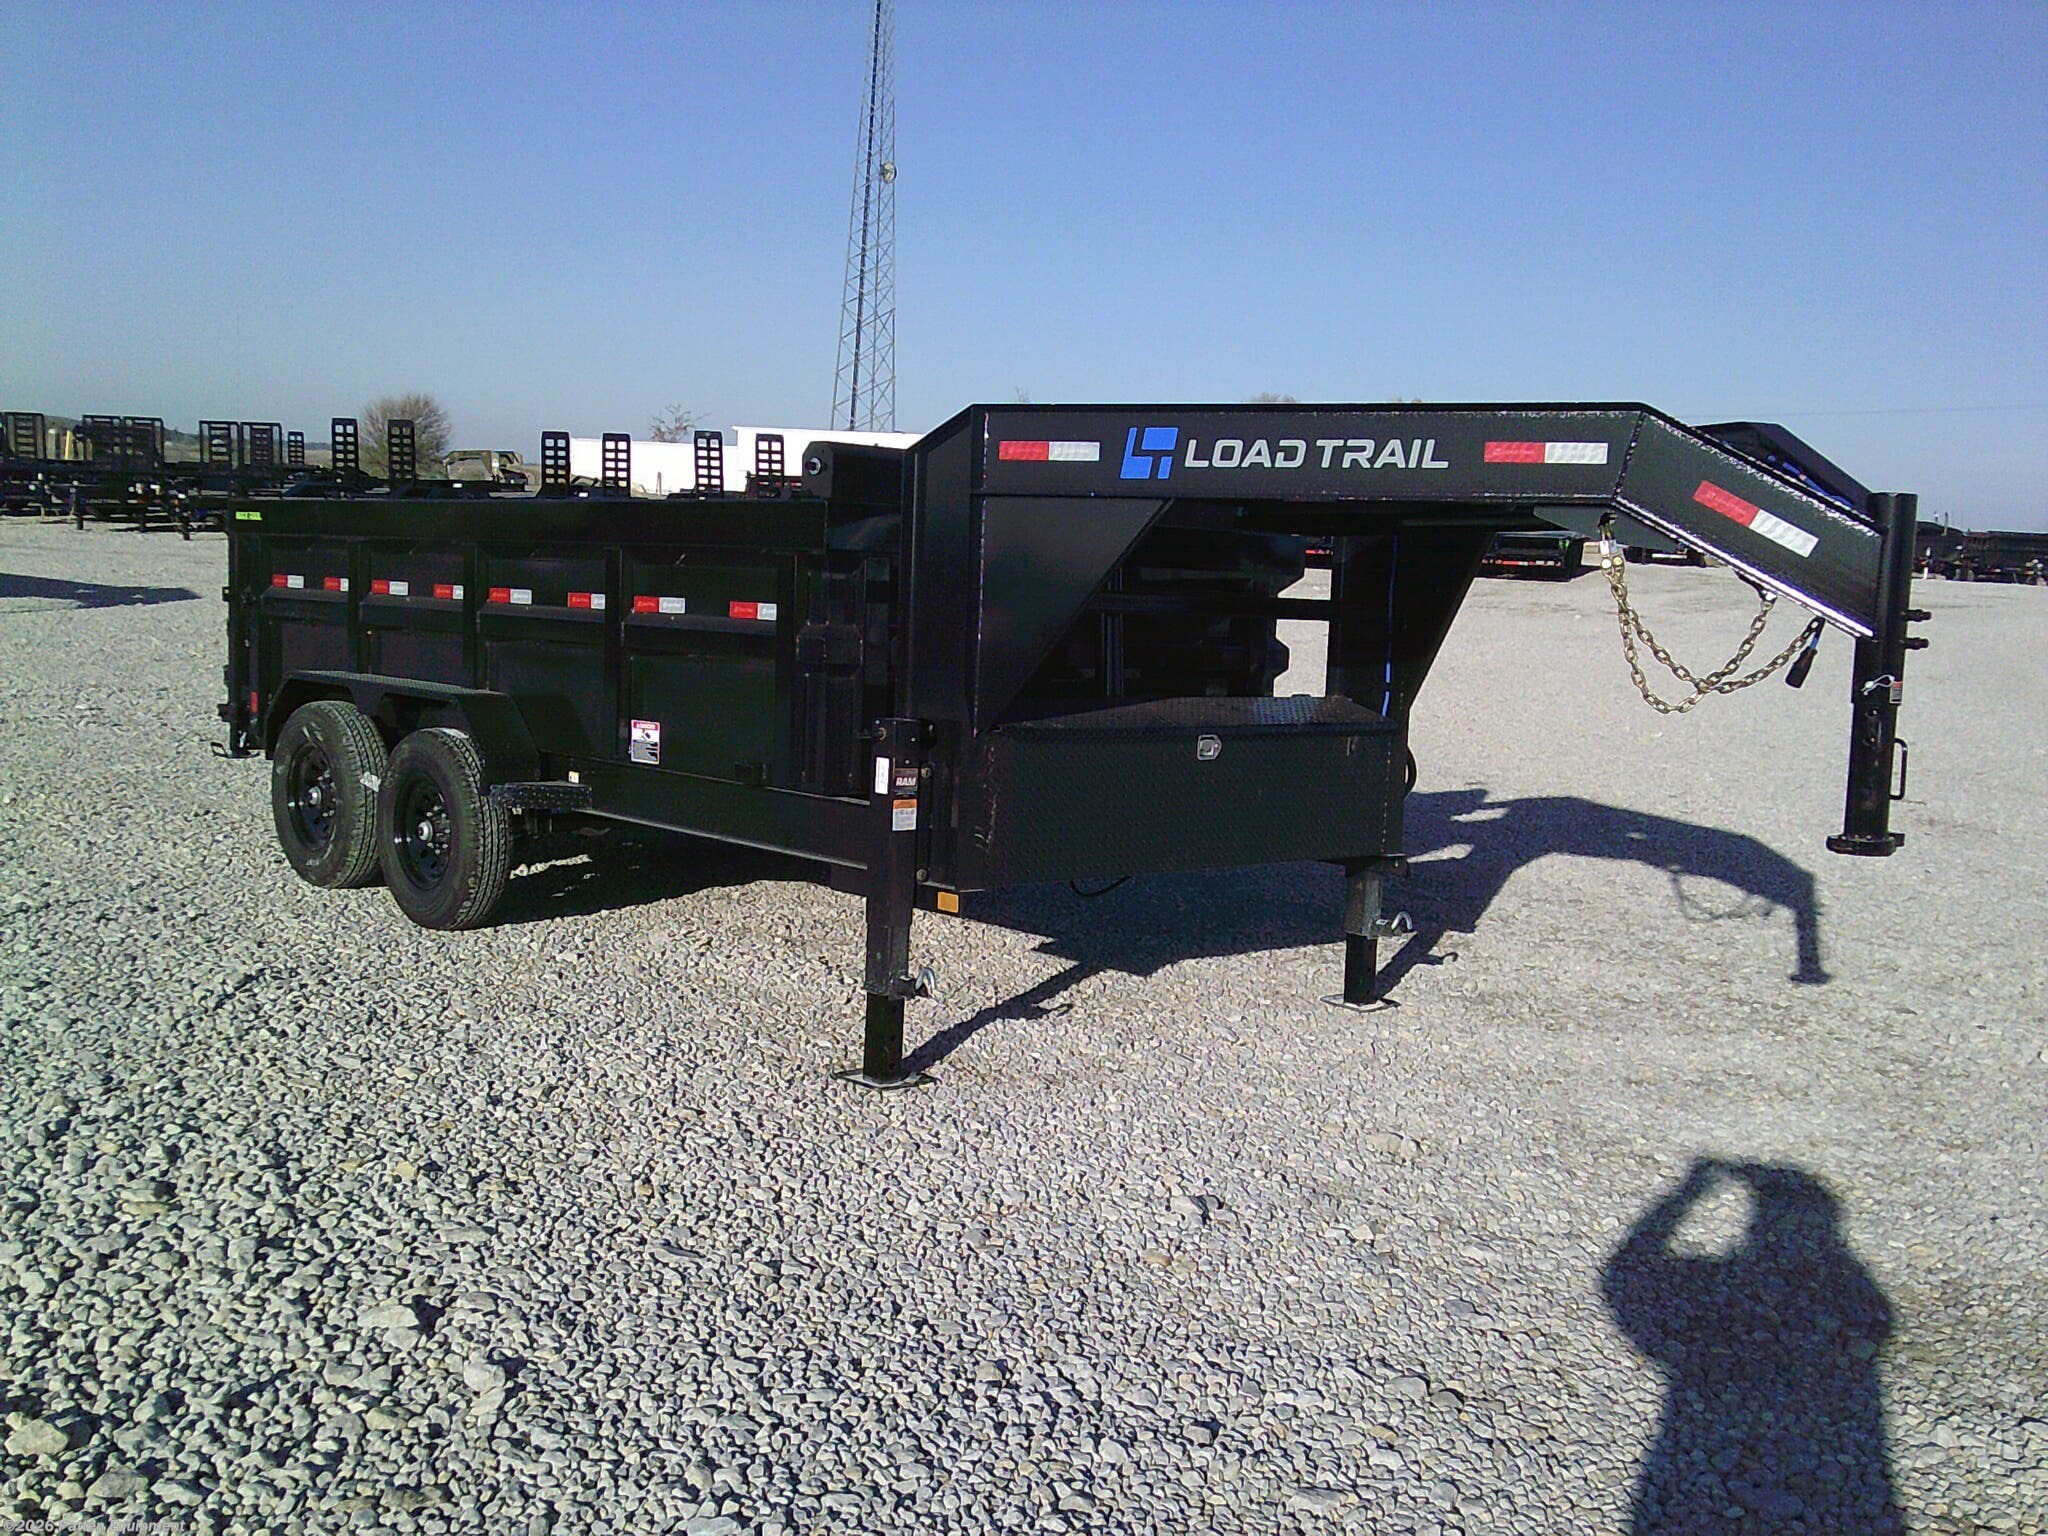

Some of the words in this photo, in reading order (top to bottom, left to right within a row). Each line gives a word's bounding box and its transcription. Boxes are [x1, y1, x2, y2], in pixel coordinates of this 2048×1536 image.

[1184, 438, 1307, 468] LOAD
[1315, 438, 1450, 469] TRAIL
[895, 777, 917, 787] RAM
